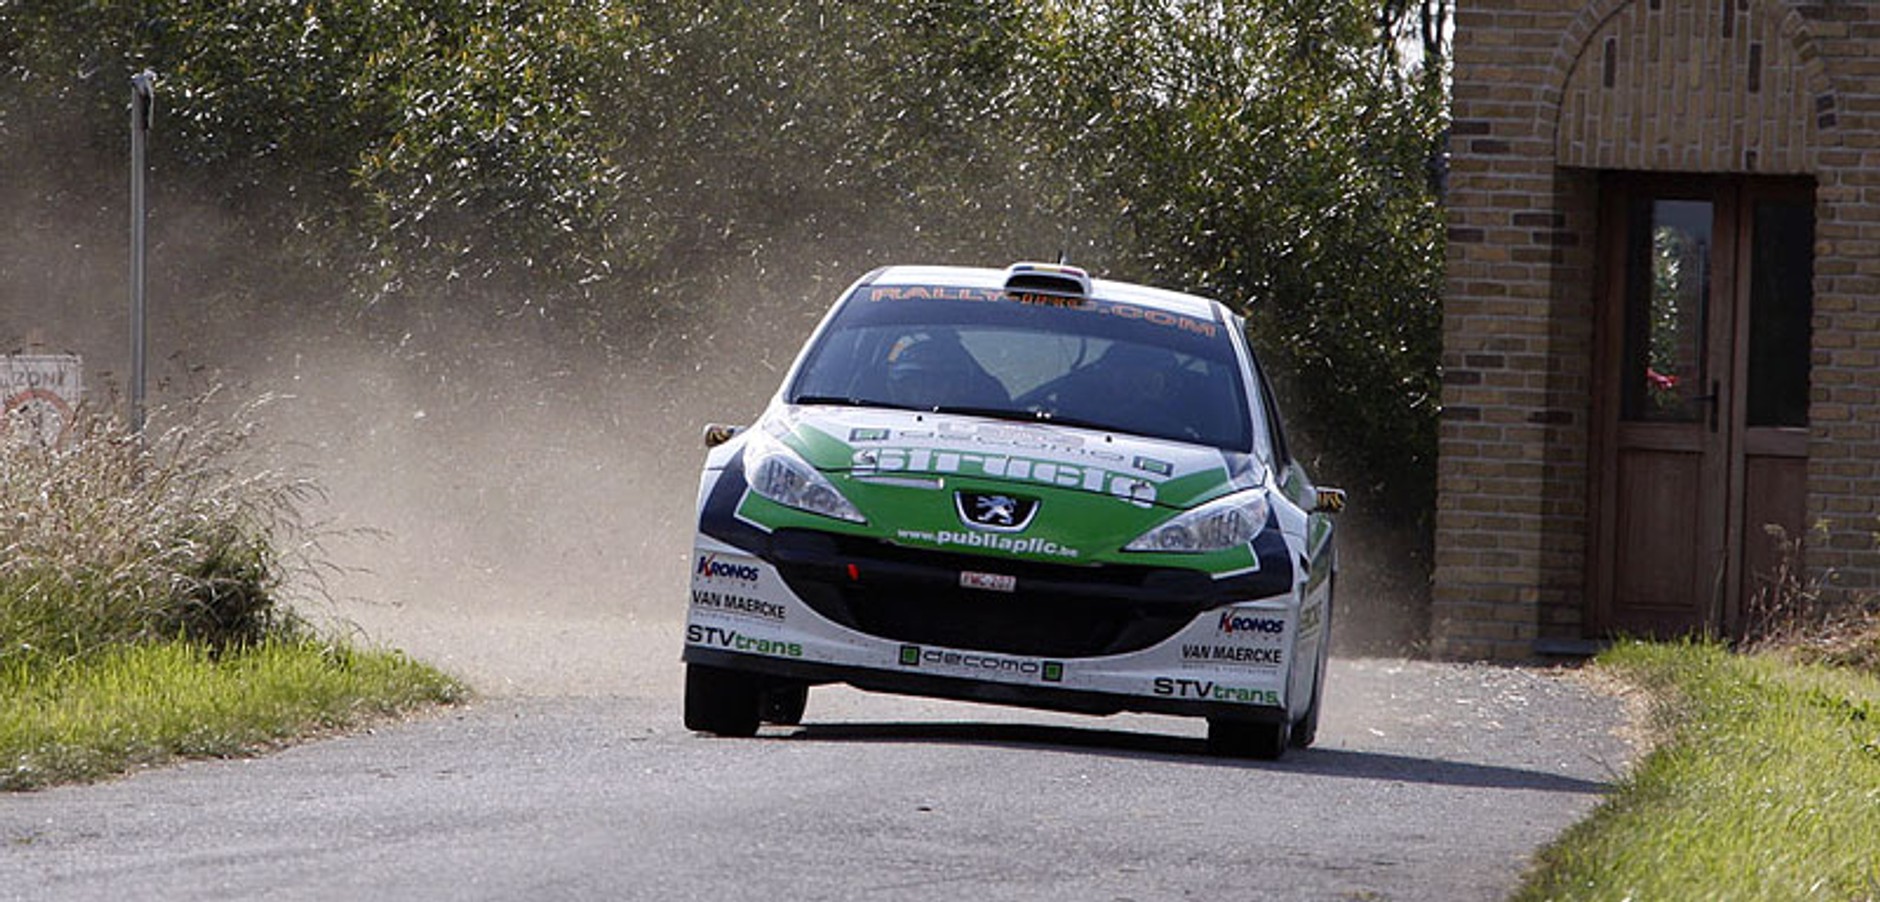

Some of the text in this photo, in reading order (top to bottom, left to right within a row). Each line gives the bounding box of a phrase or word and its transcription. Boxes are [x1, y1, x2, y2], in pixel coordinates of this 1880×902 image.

[698, 553, 760, 581] KRONOS
[692, 589, 786, 619] VAN MAERCKE
[1218, 608, 1285, 633] KRONOS
[686, 624, 803, 656] STVtrans
[923, 650, 1040, 673] decomo
[1182, 645, 1283, 664] VAN MAERCKE
[1153, 676, 1278, 703] STVtrans
